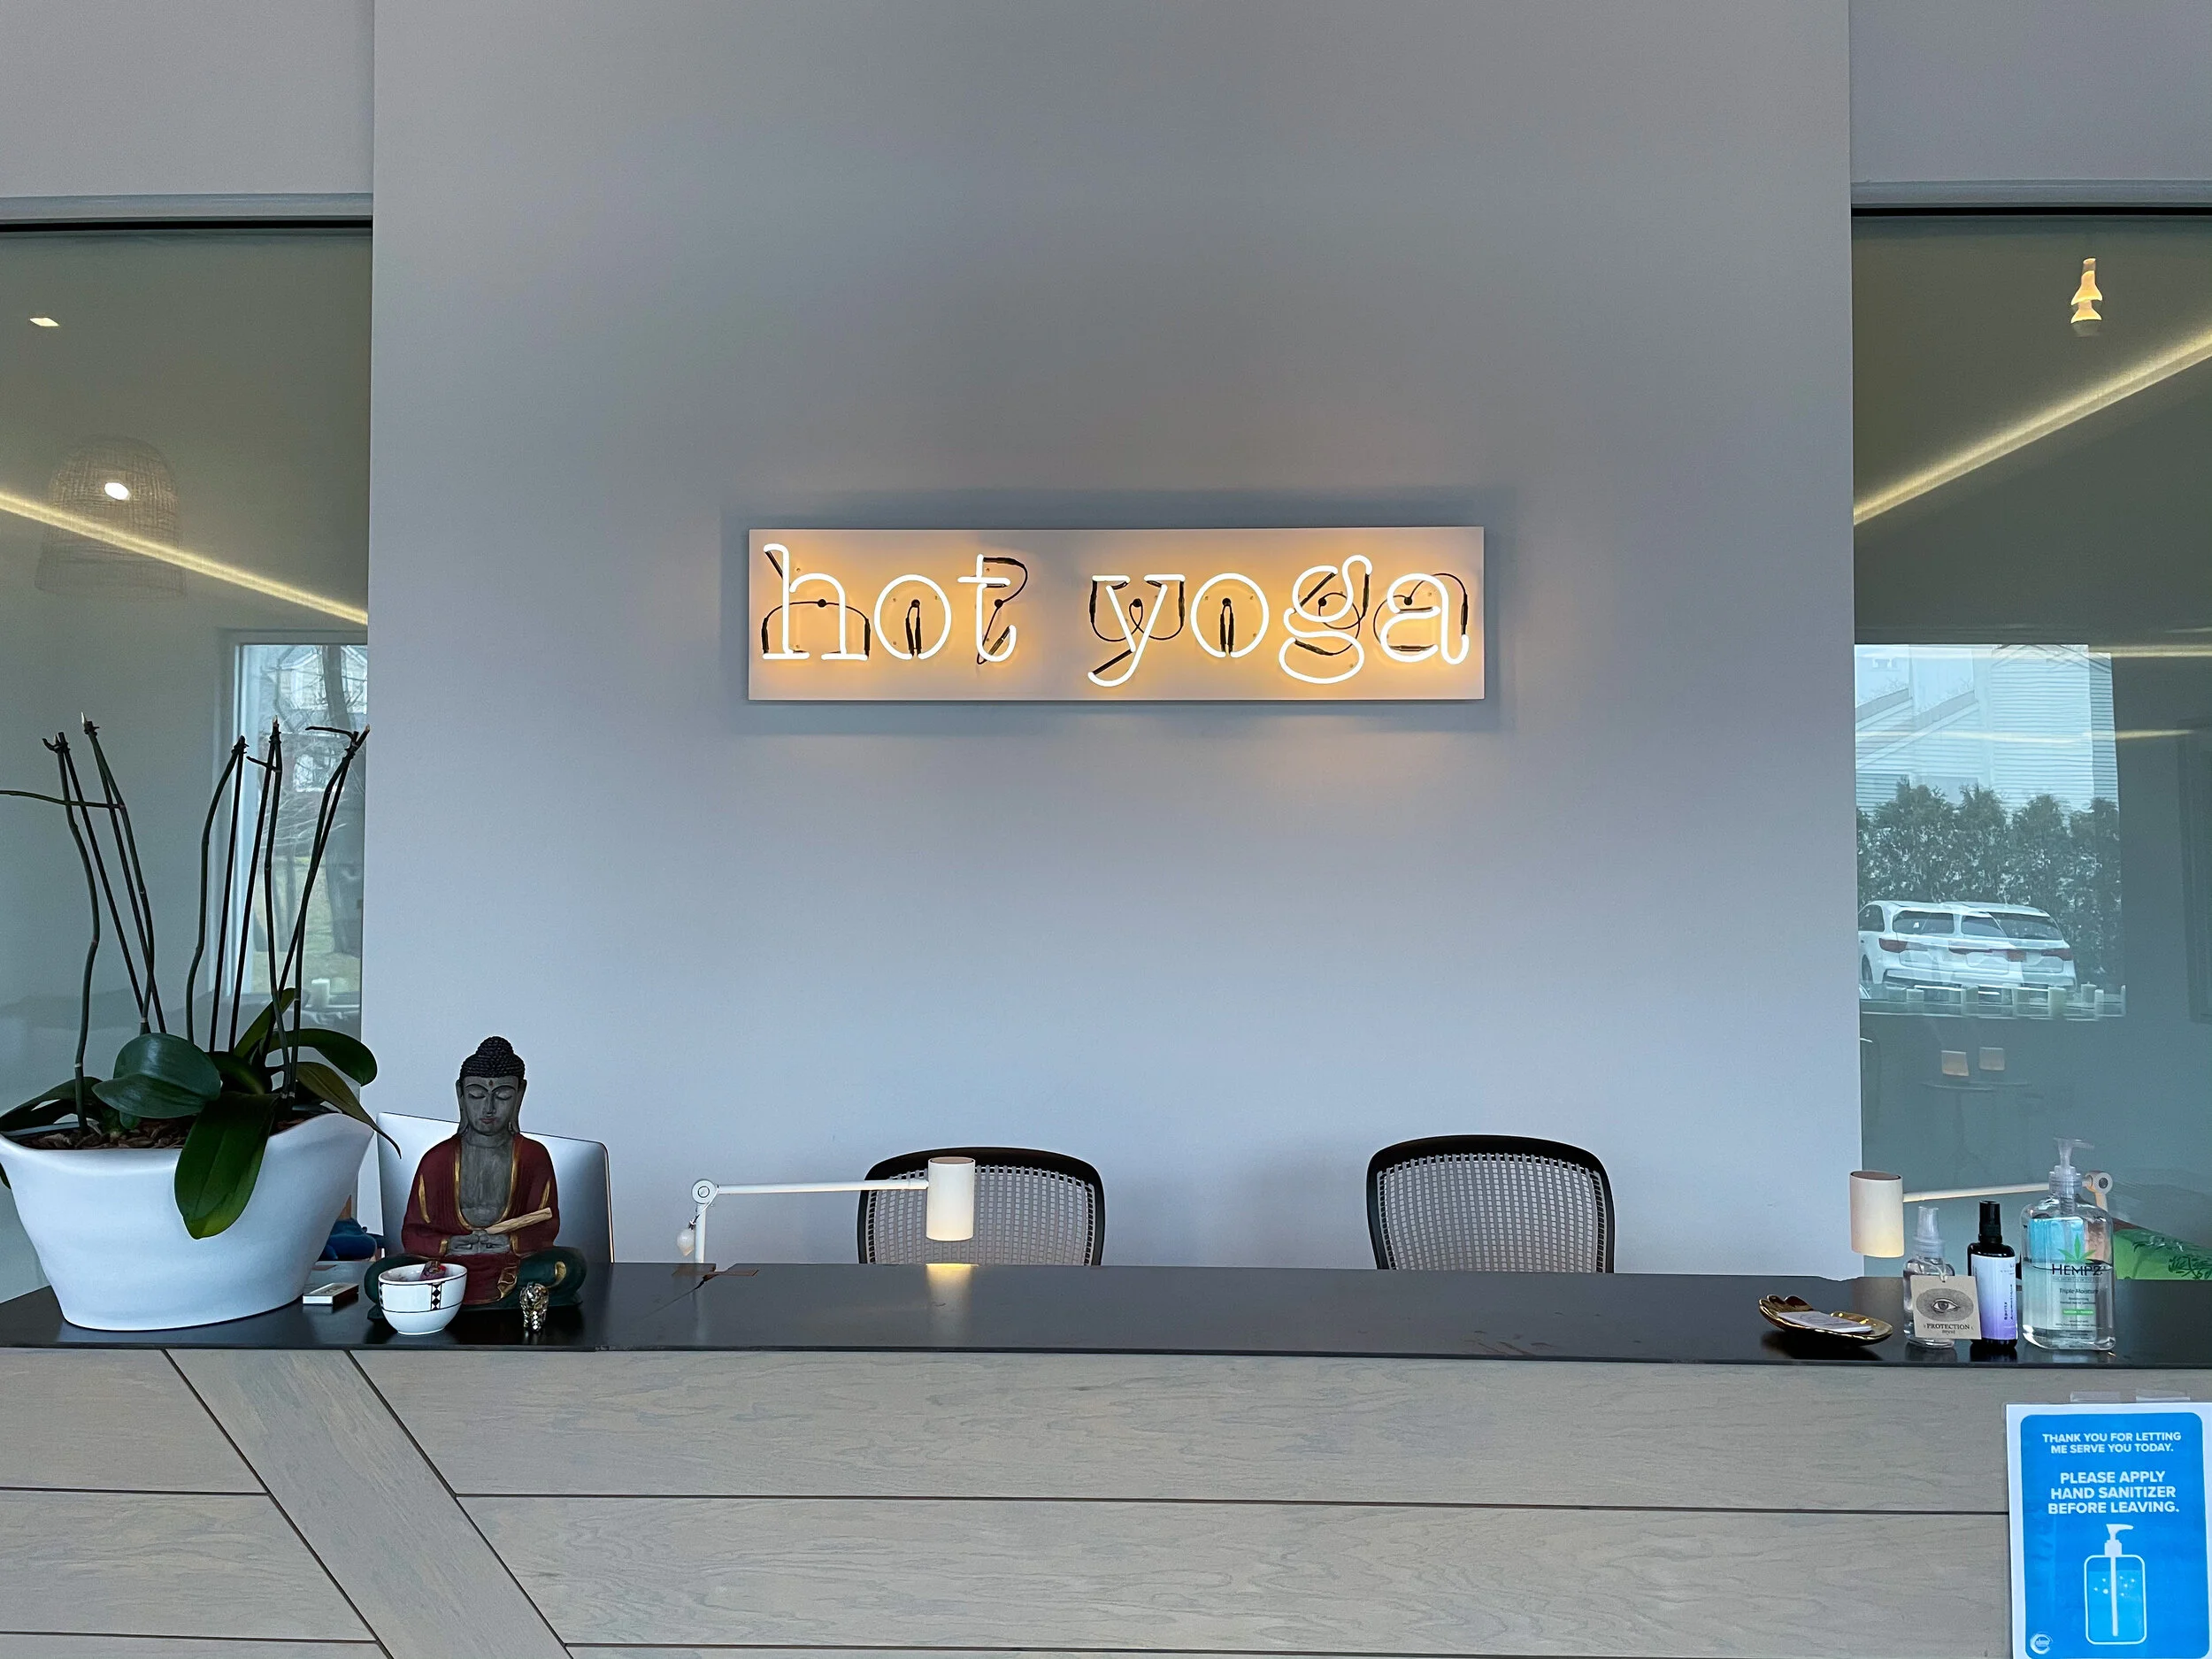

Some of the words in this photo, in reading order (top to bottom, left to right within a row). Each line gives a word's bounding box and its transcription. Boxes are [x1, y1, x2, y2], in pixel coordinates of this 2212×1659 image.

[761, 542, 1018, 664] hot
[1087, 554, 1471, 687] yoga
[2042, 1433, 2081, 1443] THANK
[2084, 1432, 2107, 1442] YOU
[2110, 1432, 2133, 1441] FOR
[2136, 1432, 2182, 1441] LETTING
[2051, 1445, 2068, 1454] ME
[2070, 1444, 2105, 1454] SERVE
[2108, 1444, 2132, 1453] YOU
[2134, 1443, 2174, 1452] TODAY.
[2060, 1471, 2116, 1484] PLEASE
[2119, 1471, 2166, 1483] APPLY
[2051, 1487, 2095, 1500] HAND
[2098, 1486, 2177, 1499] SANITIZER
[2047, 1502, 2107, 1515] BEFORE
[2110, 1501, 2180, 1513] LEAVING.
